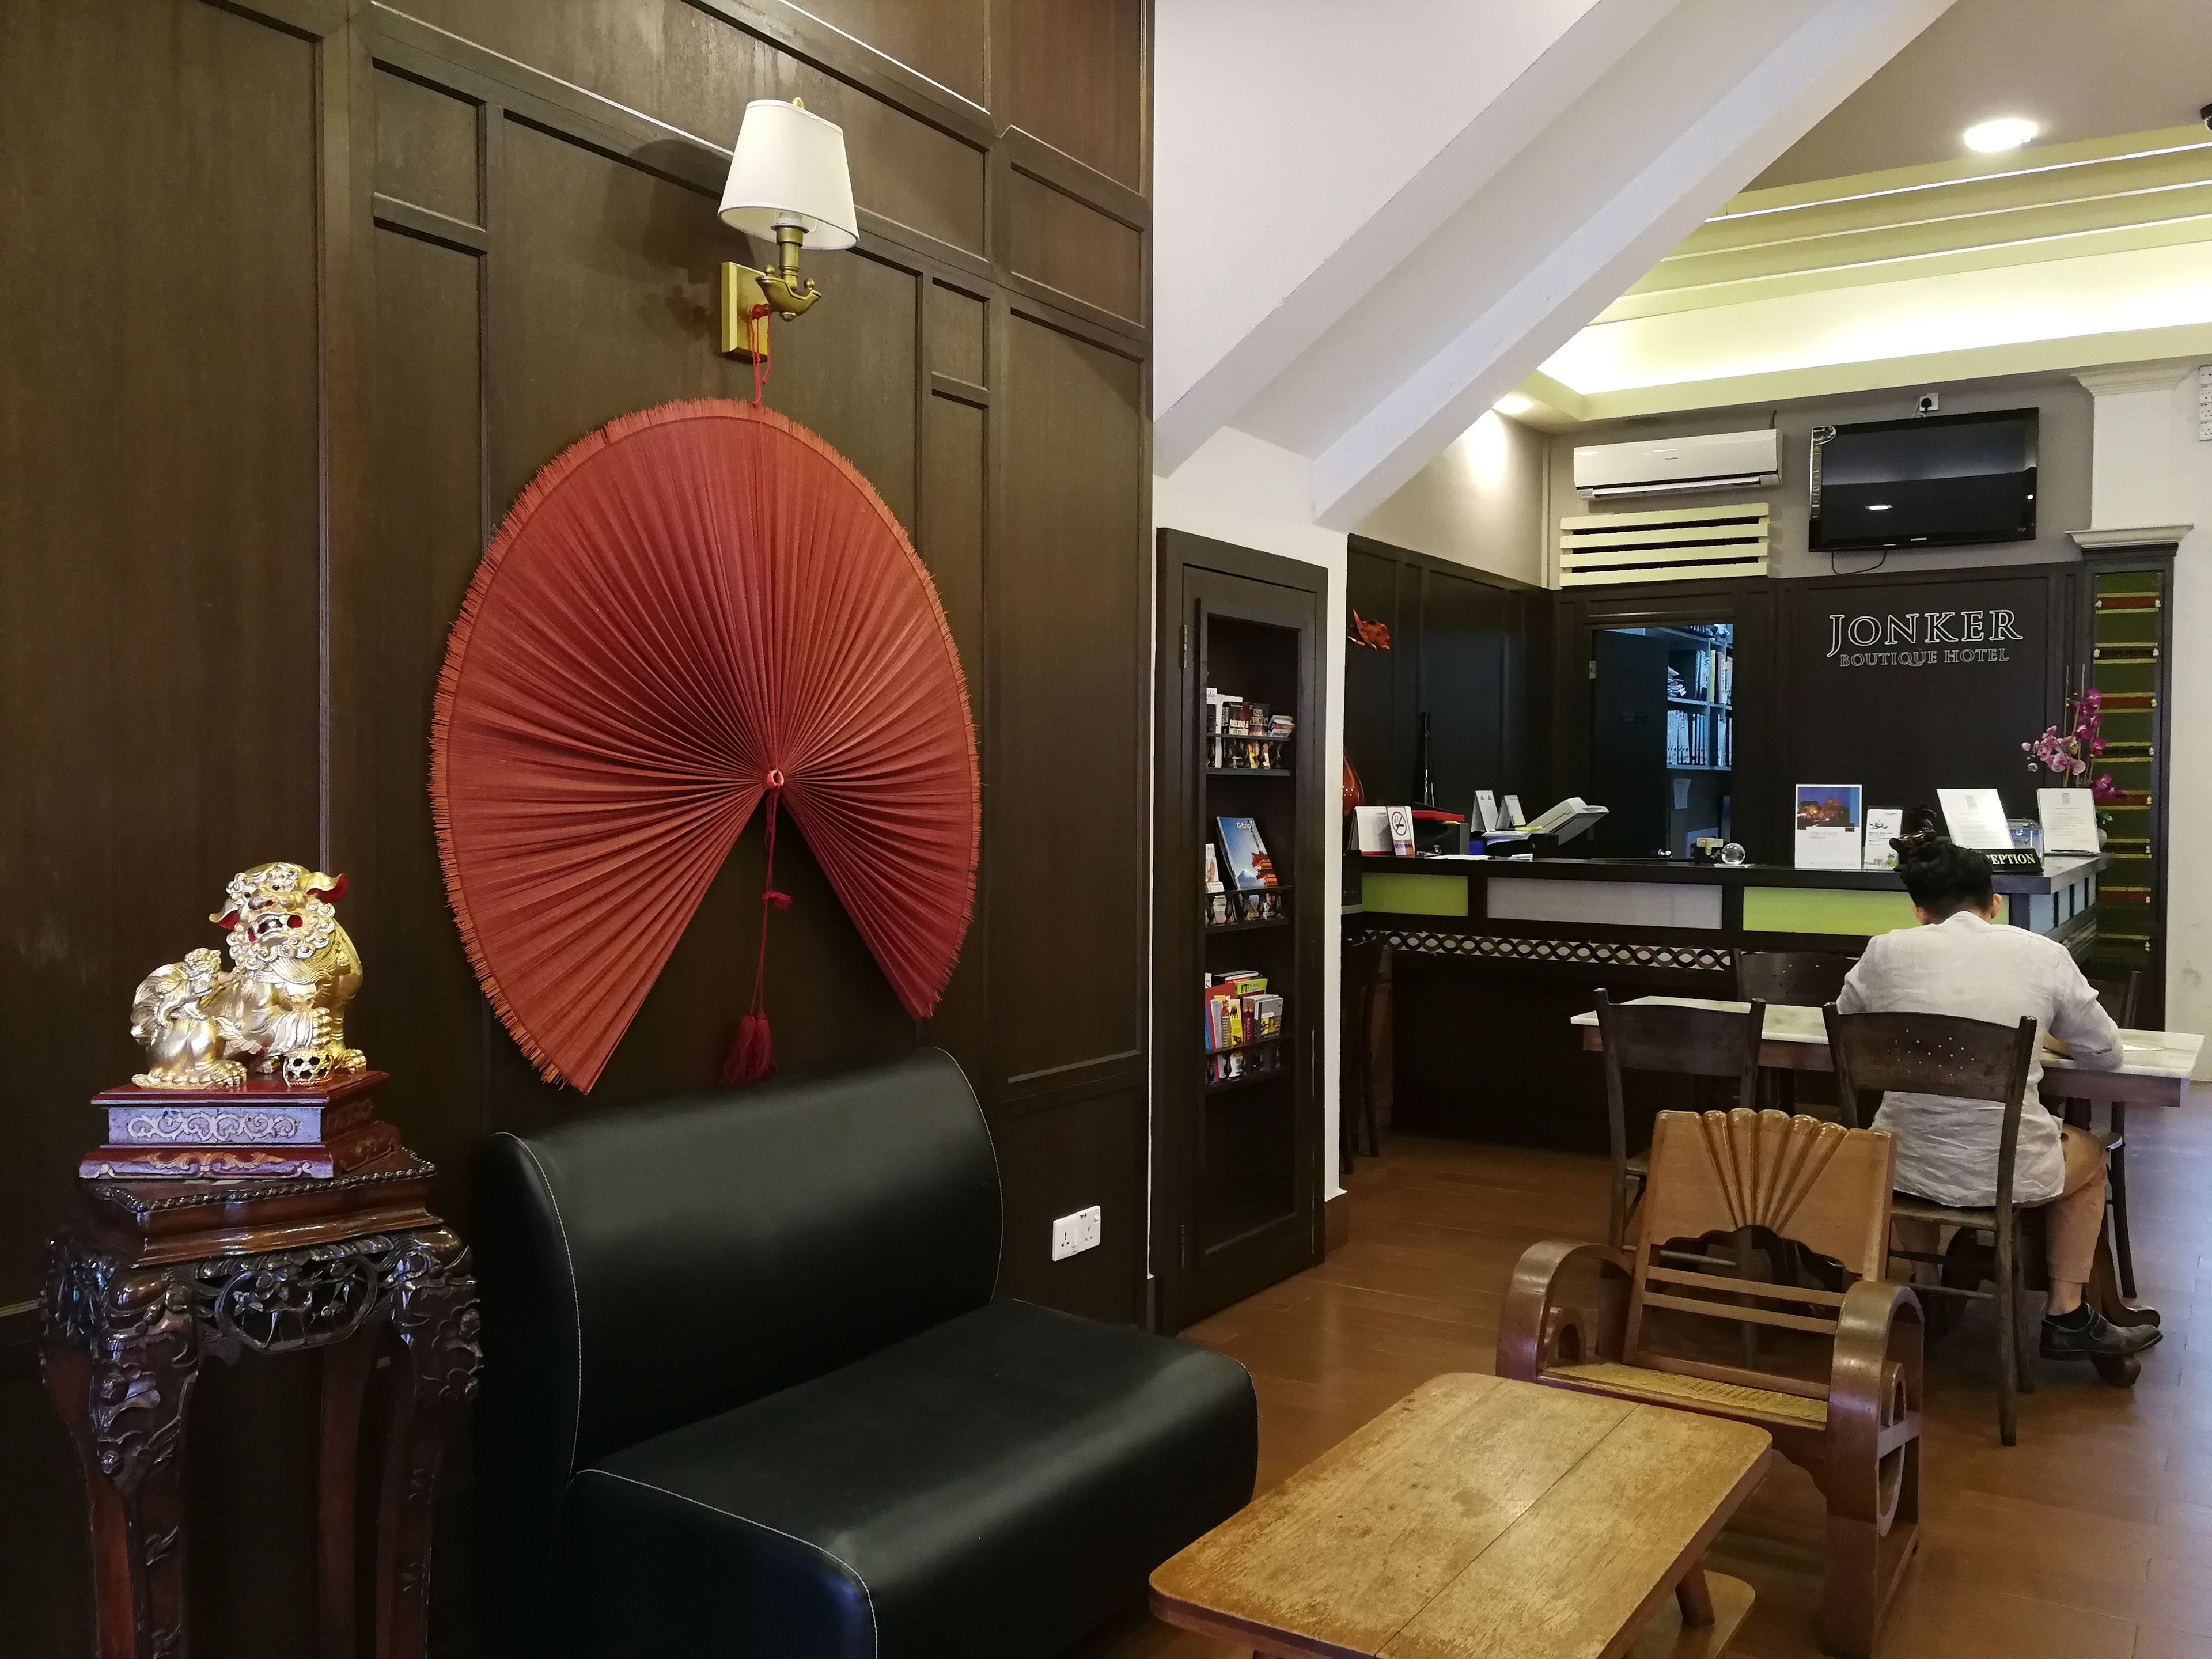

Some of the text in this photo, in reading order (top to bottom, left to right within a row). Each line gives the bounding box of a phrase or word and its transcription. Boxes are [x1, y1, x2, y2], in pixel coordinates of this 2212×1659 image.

[1827, 609, 2024, 657] JONKER
[1839, 647, 2009, 668] BOUTIQUE HOTEL
[1986, 854, 2036, 864] EPTION
